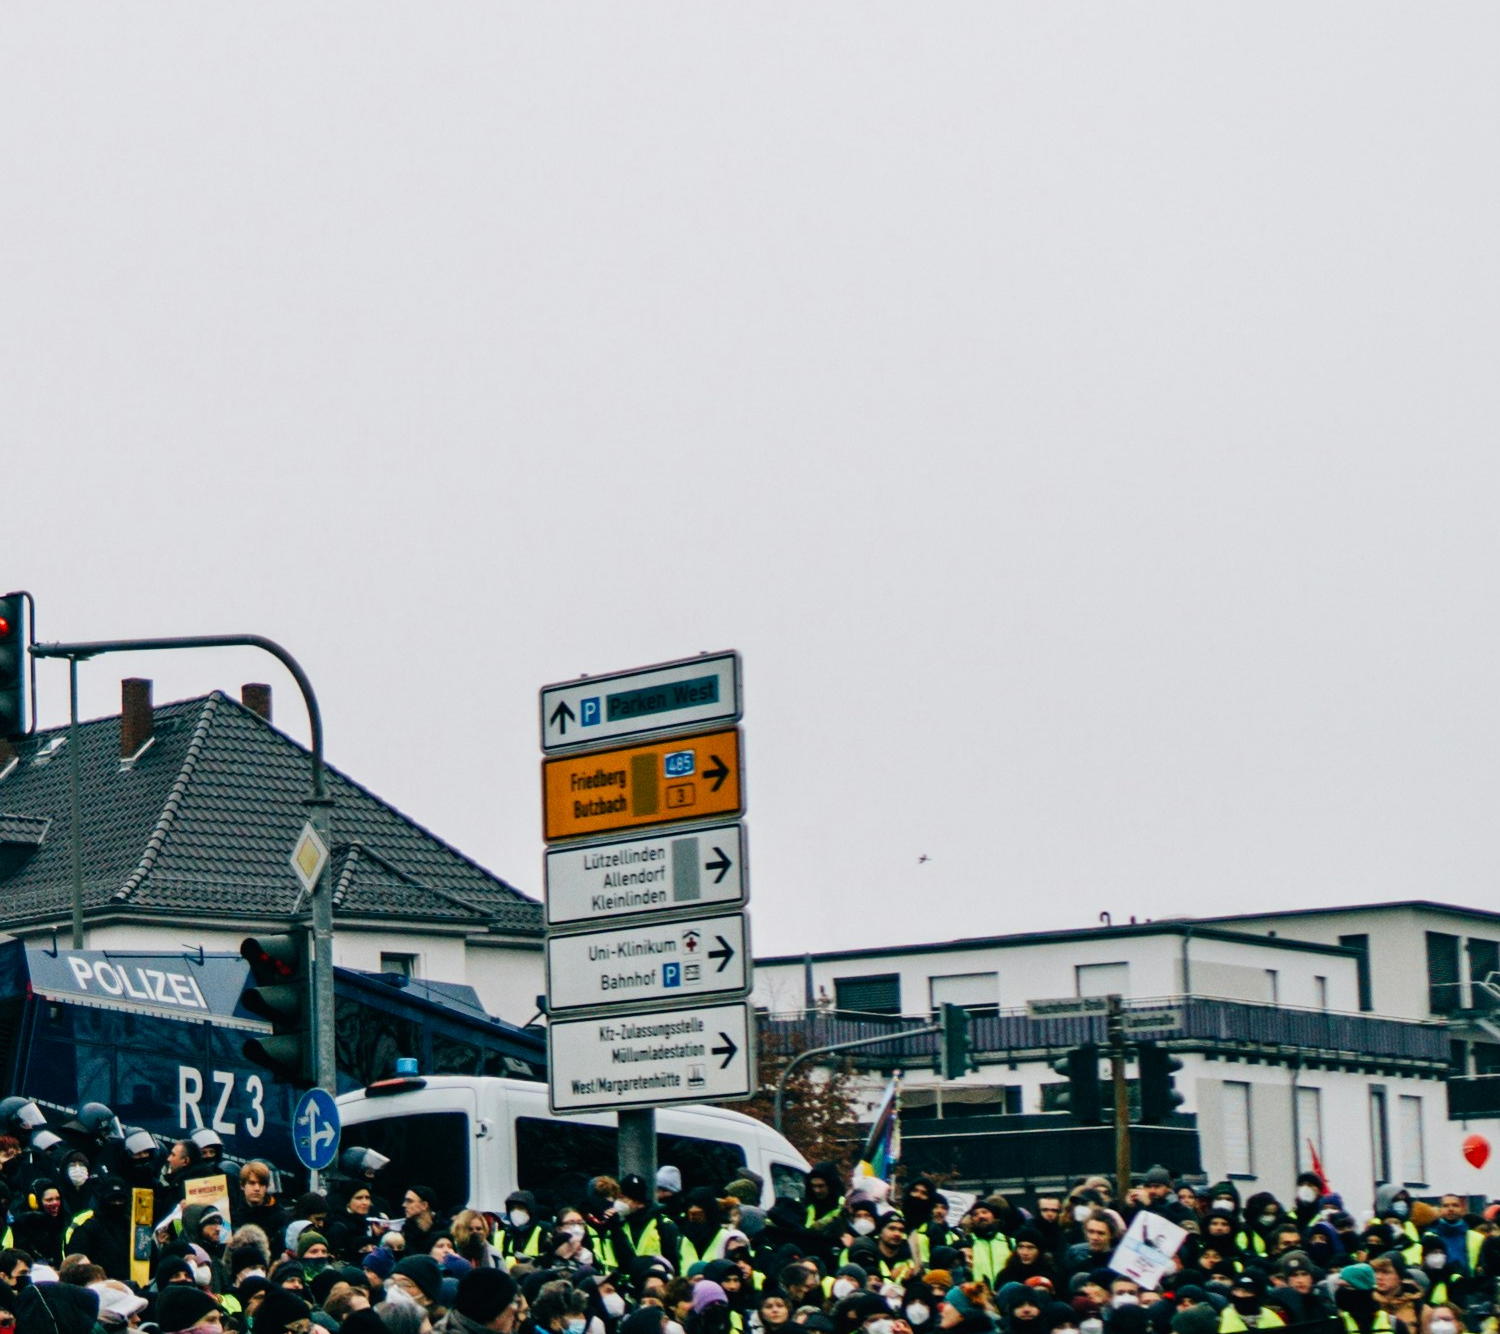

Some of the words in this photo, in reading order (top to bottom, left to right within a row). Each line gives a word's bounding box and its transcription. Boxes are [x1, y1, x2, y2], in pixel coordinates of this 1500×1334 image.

[610, 693, 667, 717] Parken
[673, 681, 715, 704] West
[668, 756, 692, 772] 485
[570, 769, 627, 791] Friedberg
[573, 794, 627, 818] Butzbach
[676, 788, 685, 803] 3
[583, 846, 665, 870] Lützellinden
[603, 866, 666, 888] Allendorf
[591, 890, 667, 911] Kleinlinden
[588, 939, 677, 961] Uni-Klinikum
[67, 956, 208, 1008] POLIZEI
[600, 969, 656, 991] Bahnhof
[599, 1017, 704, 1042] Kfz-Zulassungsstelle
[612, 1042, 705, 1064] Müllumladestation
